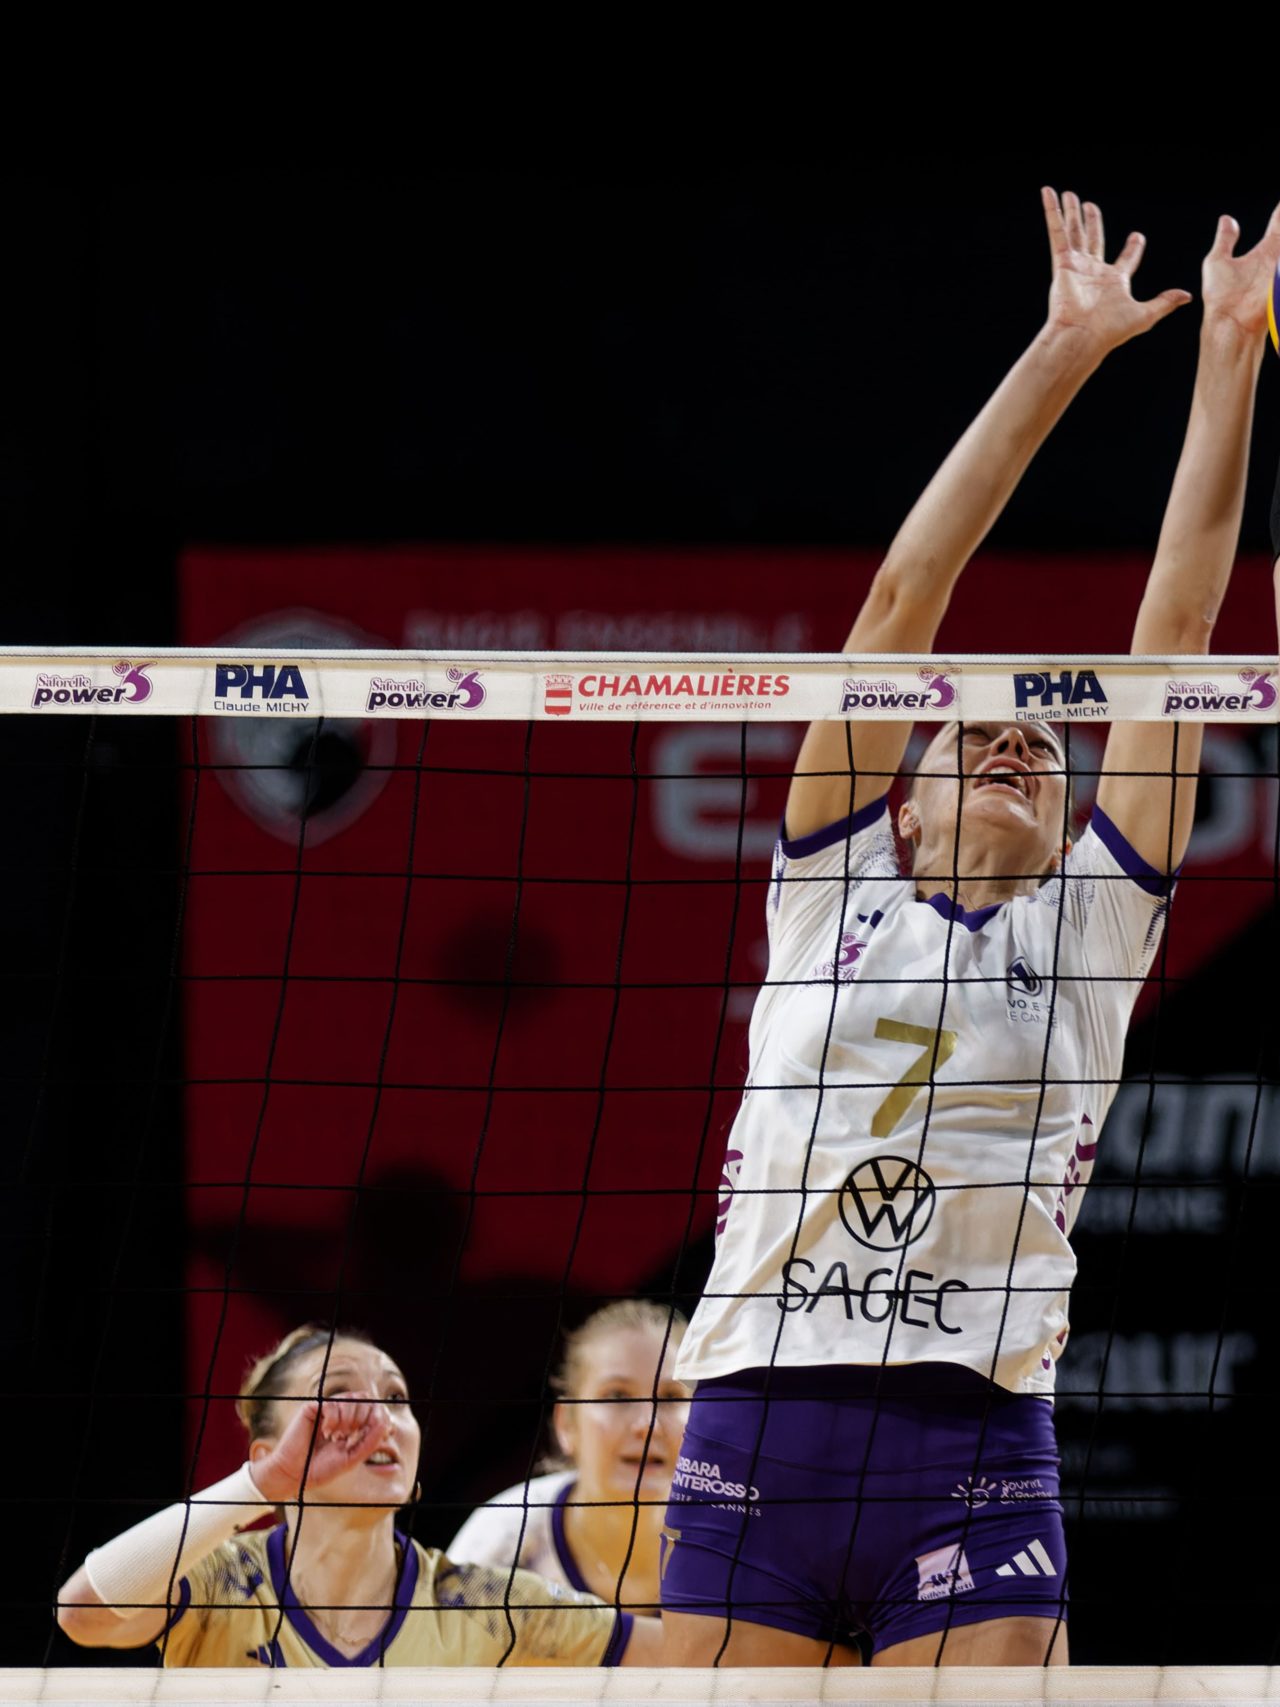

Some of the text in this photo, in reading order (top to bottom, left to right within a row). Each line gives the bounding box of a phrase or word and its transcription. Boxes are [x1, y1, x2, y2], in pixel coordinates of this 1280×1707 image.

[214, 664, 309, 699] PHA
[578, 668, 790, 697] CHAMALIÈRES
[1013, 670, 1108, 708] PHA
[213, 700, 309, 713] Claude MICHY
[579, 702, 604, 711] Ville
[607, 702, 621, 711] de
[626, 701, 681, 711] référence
[684, 702, 696, 710] et
[1015, 706, 1109, 721] Claude MICHY
[870, 1017, 958, 1138] 7
[777, 1258, 969, 1335] SAGEC
